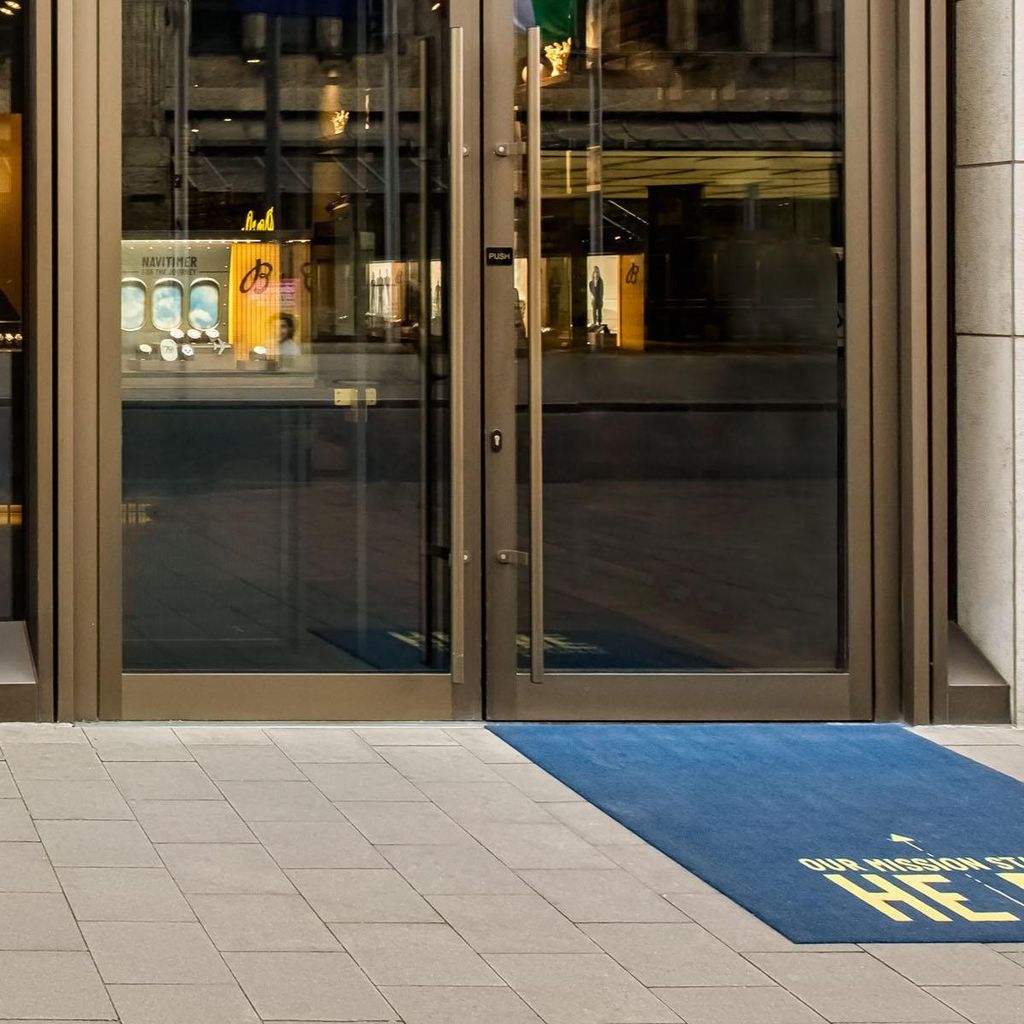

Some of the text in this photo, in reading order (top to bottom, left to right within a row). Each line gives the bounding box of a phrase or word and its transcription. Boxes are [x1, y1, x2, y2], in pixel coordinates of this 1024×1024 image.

[142, 256, 198, 268] NAVITIMER
[488, 252, 511, 260] PUSH
[798, 858, 869, 872] OUR
[862, 857, 992, 872] MISSION
[823, 872, 1024, 923] HE
